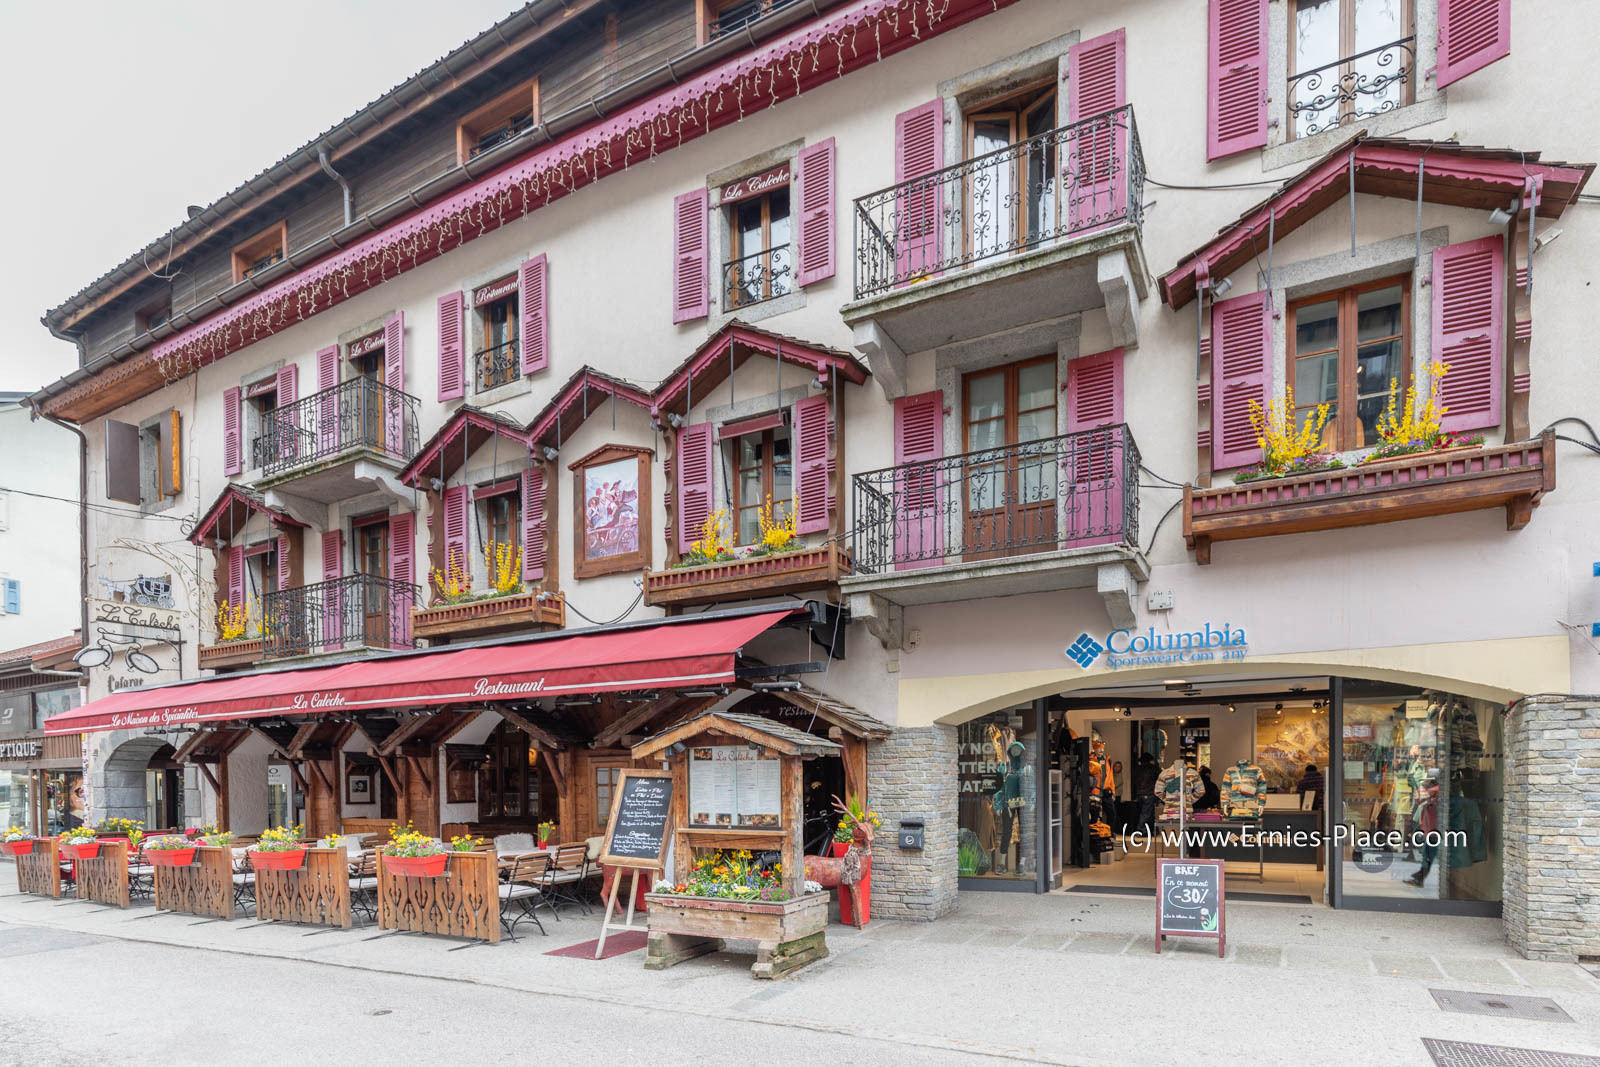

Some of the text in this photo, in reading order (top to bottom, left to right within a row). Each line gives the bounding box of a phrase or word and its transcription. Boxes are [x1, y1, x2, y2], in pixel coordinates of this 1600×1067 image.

[722, 169, 790, 201] La Calèche
[96, 603, 180, 630] La Calèche
[1106, 622, 1248, 655] Columbia
[1106, 652, 1178, 670] Sportswear
[471, 677, 545, 697] Restaurant
[291, 692, 345, 709] La Calèche
[112, 707, 199, 727] La Maison des Spécialités
[1164, 876, 1176, 886] En
[1174, 866, 1200, 877] BREF,
[1173, 888, 1209, 904] -30%
